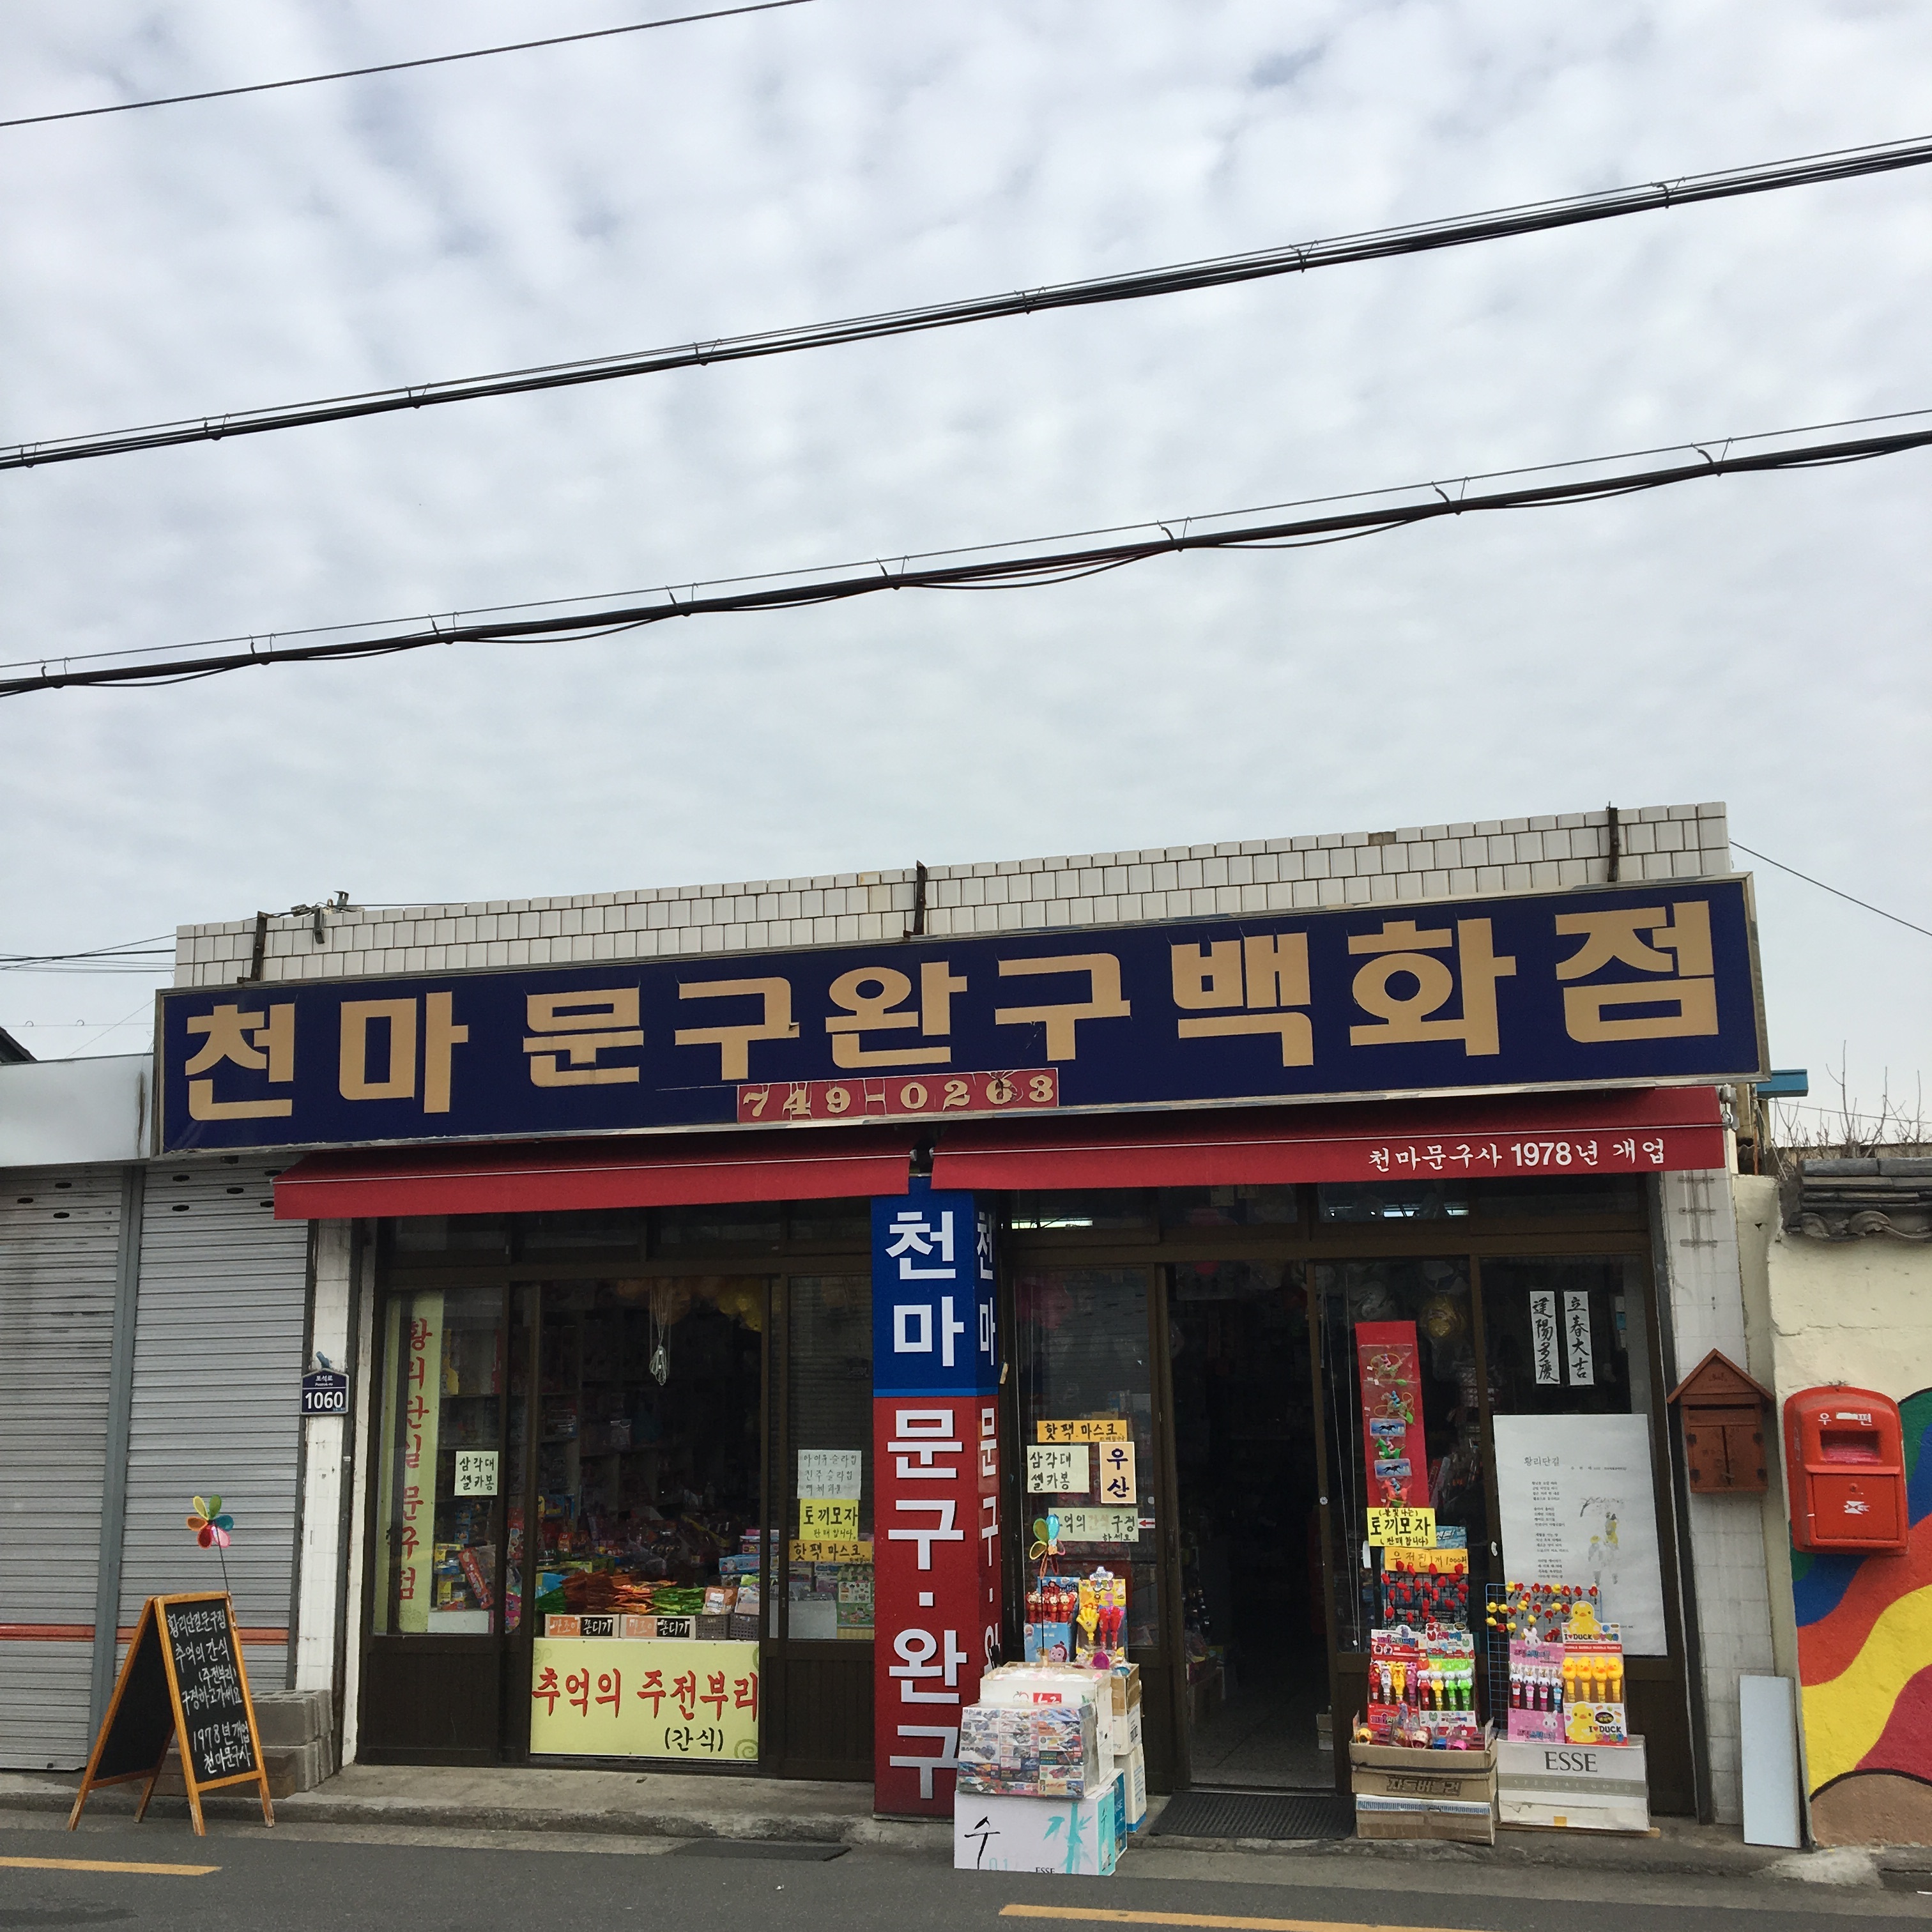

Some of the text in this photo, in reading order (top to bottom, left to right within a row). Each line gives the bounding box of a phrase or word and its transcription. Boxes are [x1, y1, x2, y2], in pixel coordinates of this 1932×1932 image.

[185, 992, 468, 1121] 천마
[742, 1074, 1054, 1117] 749-0263
[1368, 1137, 1666, 1174] 천마문구사 1978년 개업
[885, 1211, 965, 1367] 천마
[977, 1211, 996, 1366] 천마
[1567, 1296, 1590, 1379] 立春大吉
[305, 1391, 343, 1409] 1060
[459, 1456, 495, 1472] 삼각대
[1030, 1451, 1071, 1469] 삼각대
[1524, 1456, 1560, 1467] 황리단길
[460, 1474, 494, 1491] 셀카봉
[1031, 1471, 1071, 1492] 셀카봉
[1106, 1448, 1130, 1498] 우산
[803, 1505, 859, 1527] 토끼모자
[1059, 1513, 1085, 1534] 억의
[1111, 1514, 1135, 1533] 구경
[1370, 1516, 1431, 1537] 토끼모자
[175, 1636, 230, 1673] 추억의 간식
[532, 1667, 759, 1722] 추억의 주전부리
[664, 1726, 723, 1752] (간식)
[1544, 1751, 1598, 1773] ESSE
